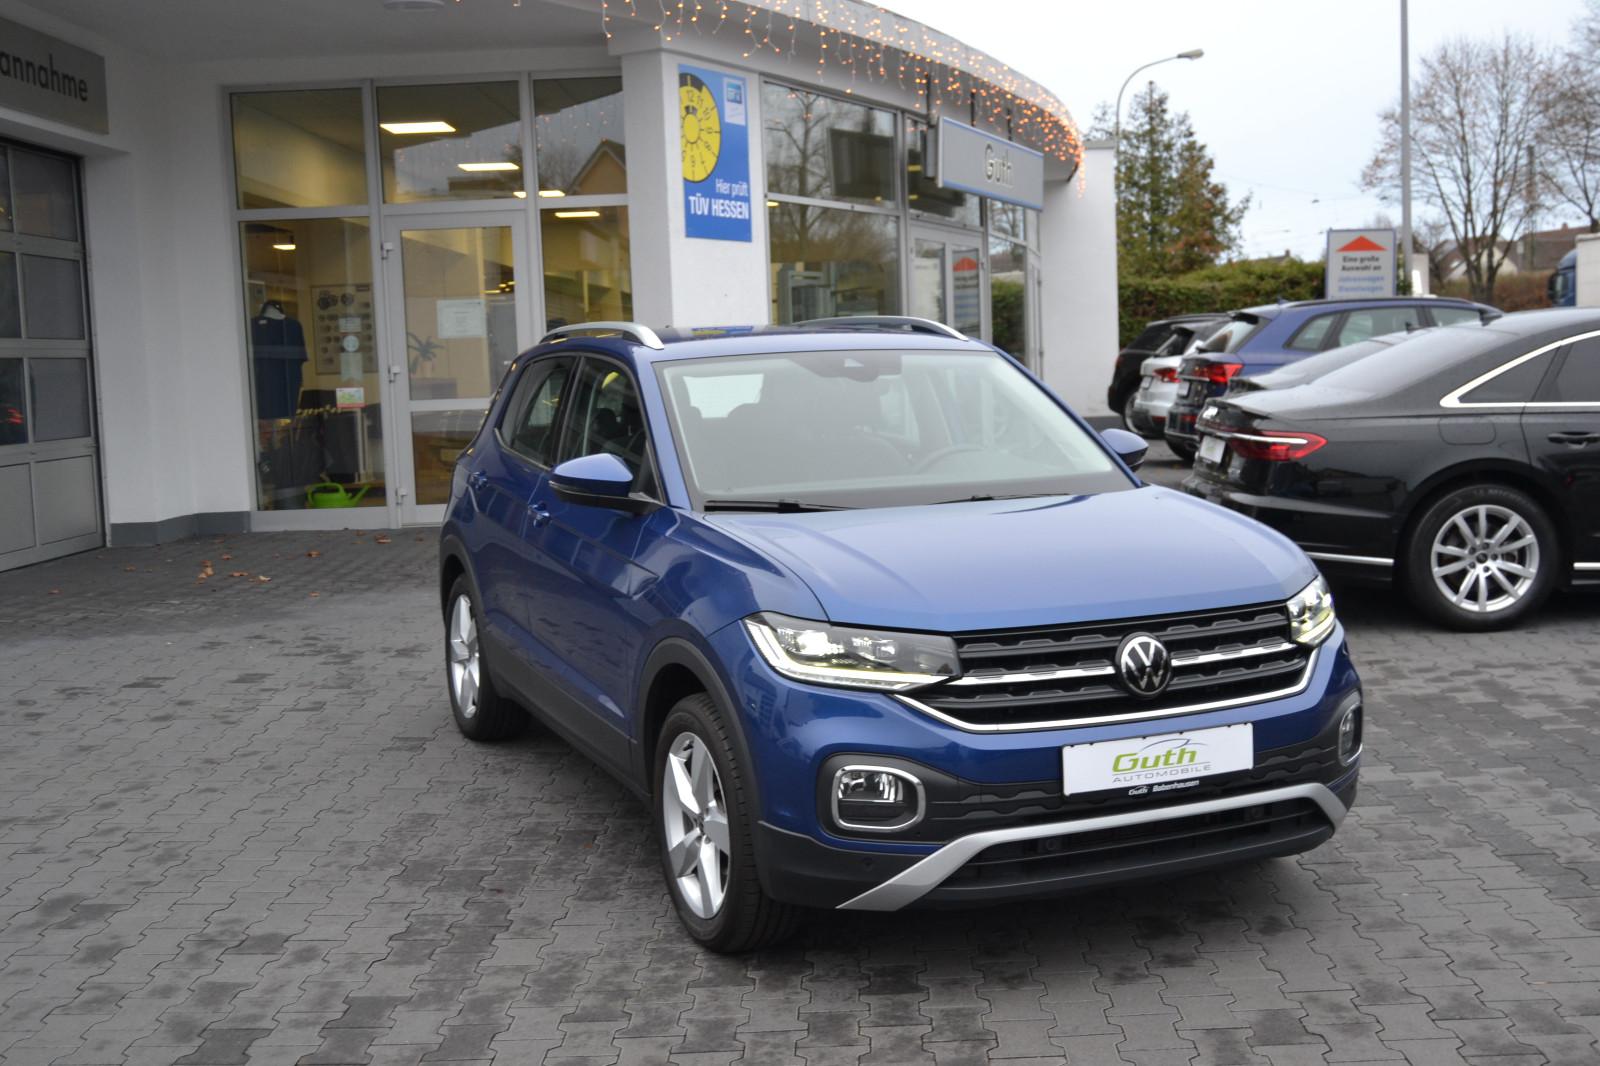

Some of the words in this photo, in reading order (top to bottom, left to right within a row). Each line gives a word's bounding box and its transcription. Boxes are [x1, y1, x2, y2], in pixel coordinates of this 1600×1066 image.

[984, 143, 1013, 187] Guth
[716, 179, 730, 194] Hier
[688, 192, 709, 215] TÜV
[711, 198, 749, 219] HESSEN
[1112, 747, 1197, 773] Guth
[1112, 764, 1212, 783] AUTOMOBILE
